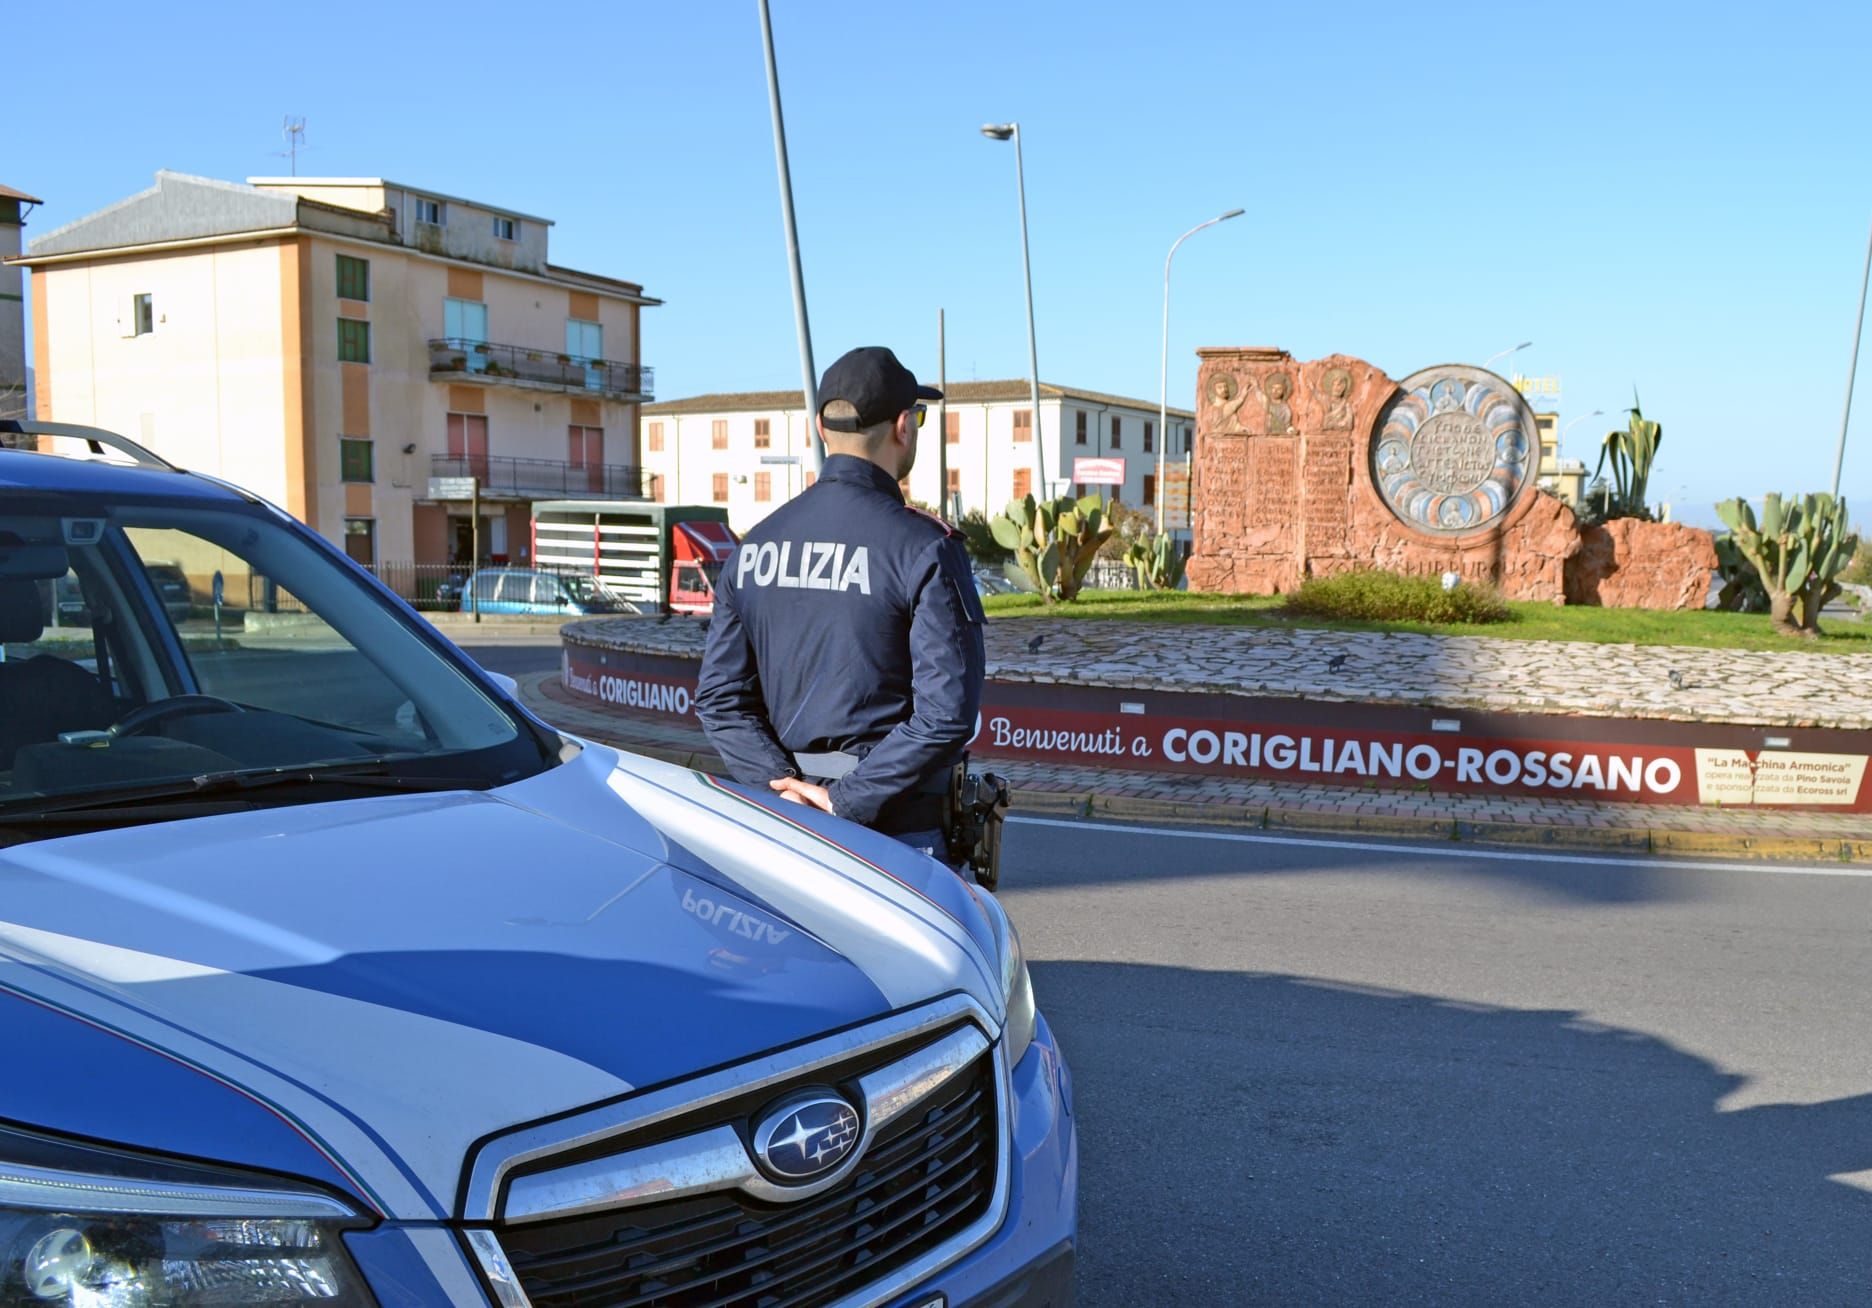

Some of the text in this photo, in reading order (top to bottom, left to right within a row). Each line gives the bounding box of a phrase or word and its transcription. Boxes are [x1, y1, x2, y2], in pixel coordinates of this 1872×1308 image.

[737, 541, 871, 595] POLIZIA
[990, 717, 1125, 756] Benvenuti
[1131, 736, 1152, 757] a
[1163, 728, 1681, 793] CORIGLIANO-ROSSANO
[1796, 774, 1817, 783] Pino
[1820, 776, 1851, 785] Savoia
[1797, 786, 1834, 795] Ecoross
